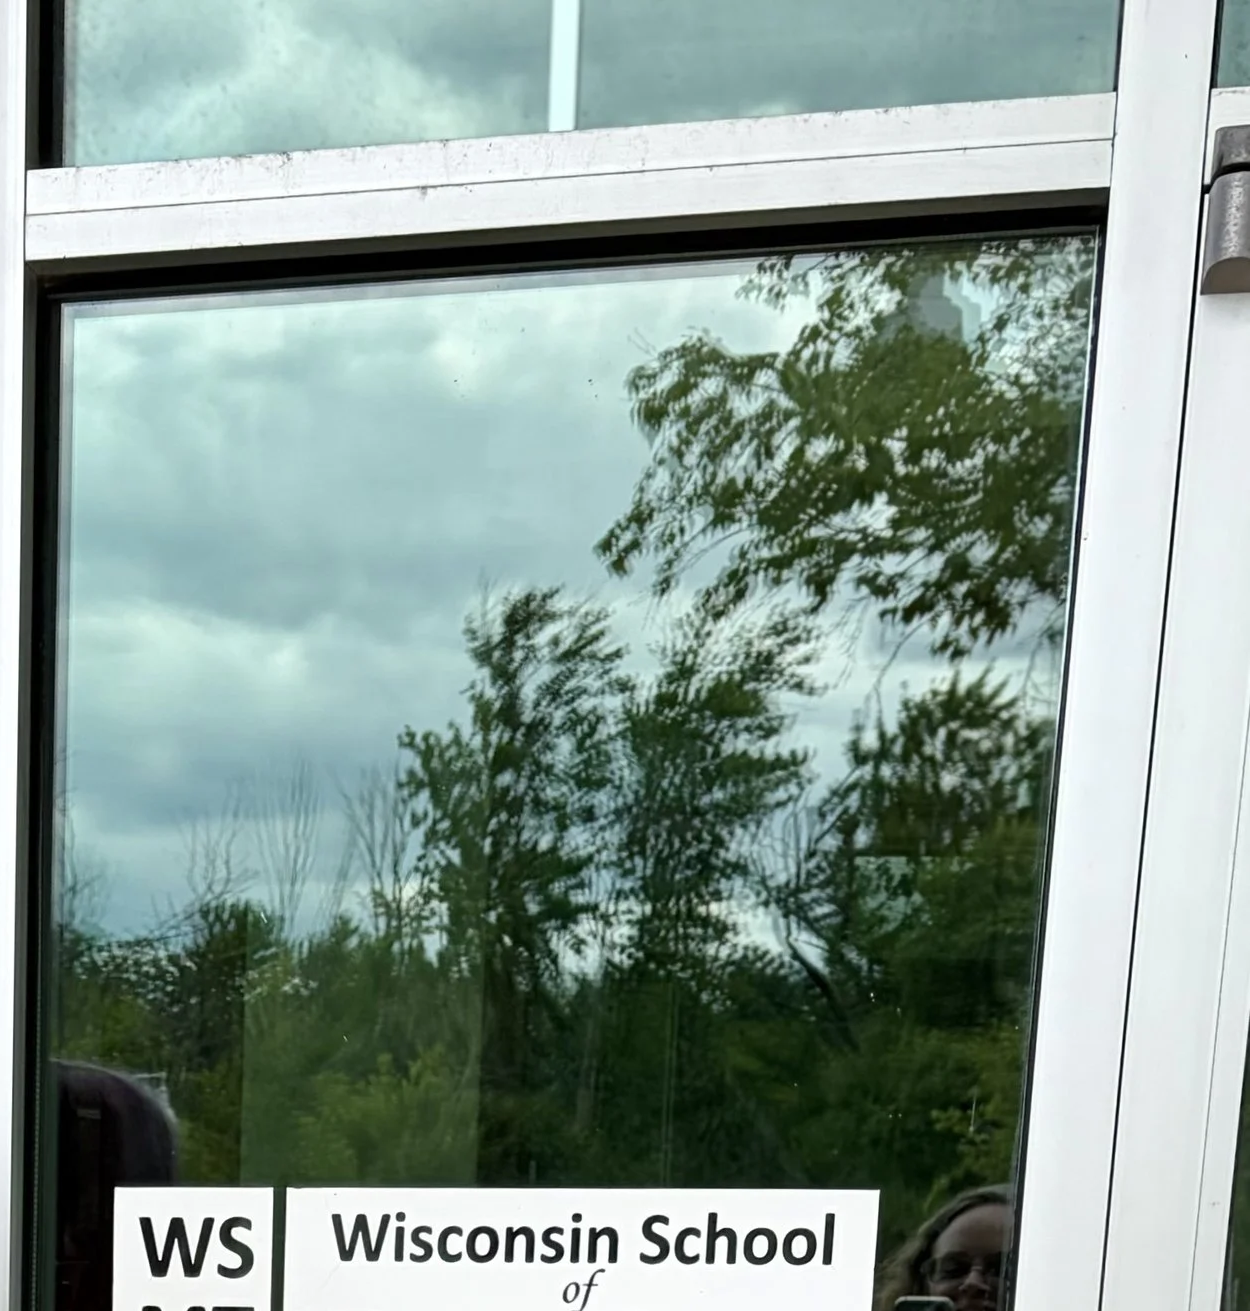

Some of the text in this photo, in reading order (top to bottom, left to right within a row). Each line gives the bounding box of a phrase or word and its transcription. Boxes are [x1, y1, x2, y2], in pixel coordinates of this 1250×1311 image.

[139, 1216, 254, 1279] WS
[331, 1212, 836, 1266] Wisconsin School
